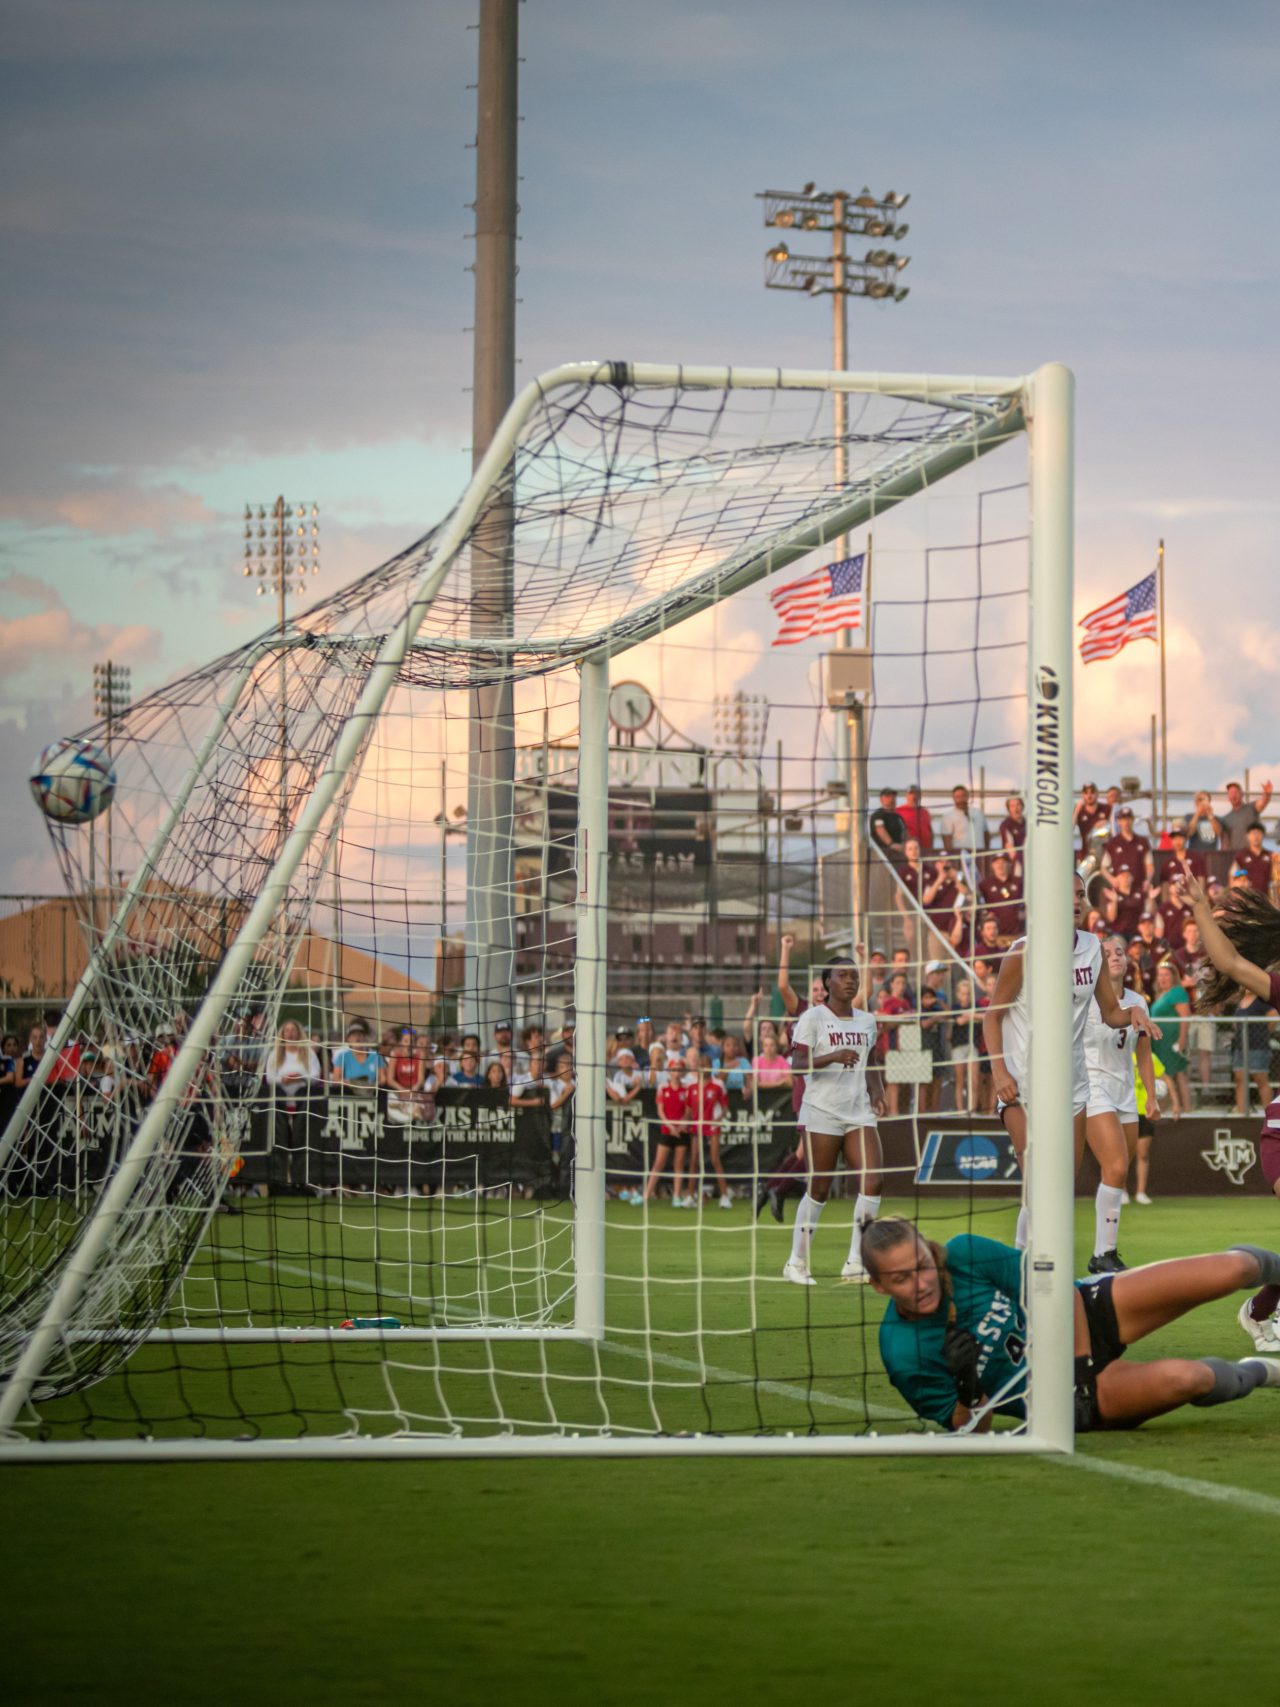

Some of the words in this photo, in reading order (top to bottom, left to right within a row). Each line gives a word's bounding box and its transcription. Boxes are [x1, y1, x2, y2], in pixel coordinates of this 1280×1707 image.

[1072, 966, 1093, 986] ATE
[829, 1032, 843, 1046] NM
[1117, 1029, 1127, 1049] 3
